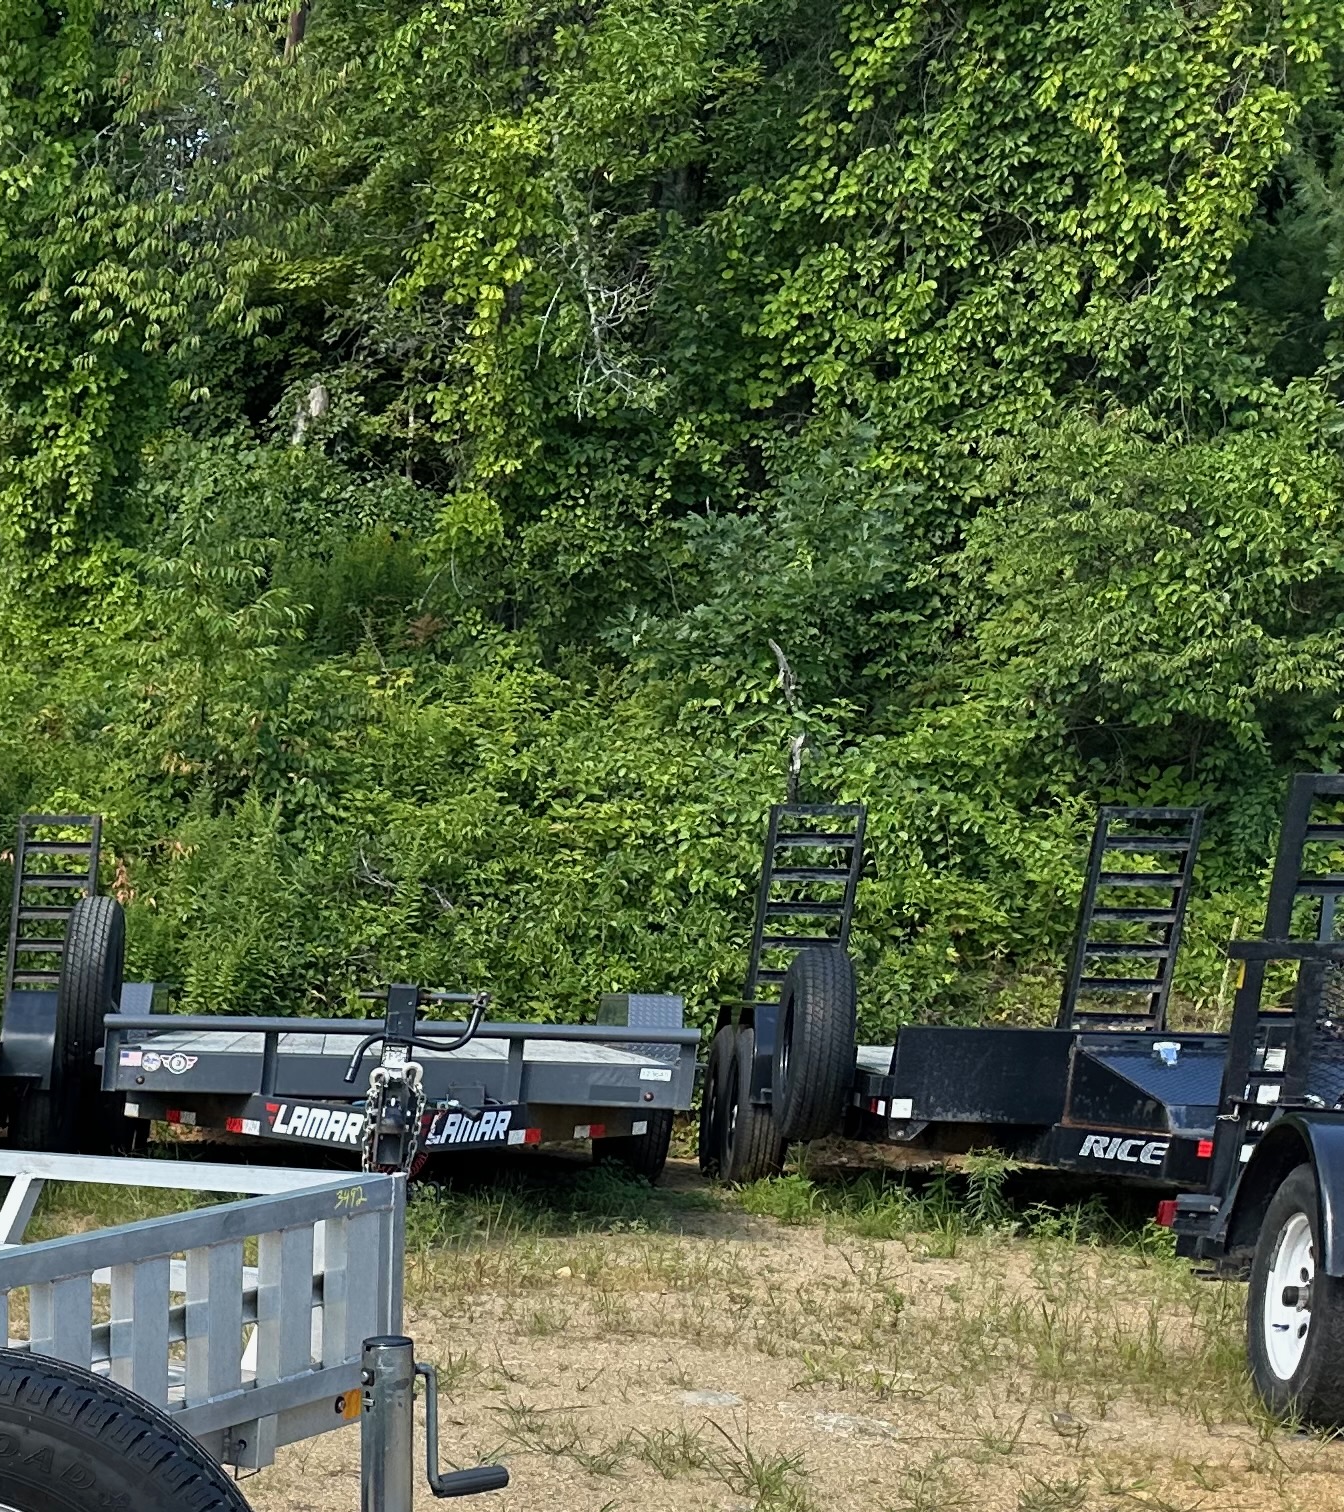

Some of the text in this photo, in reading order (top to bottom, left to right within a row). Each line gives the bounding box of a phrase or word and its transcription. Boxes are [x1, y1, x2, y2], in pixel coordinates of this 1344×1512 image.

[272, 1103, 365, 1145] LAMAR
[425, 1110, 512, 1146] LAMAR
[1078, 1134, 1170, 1165] RICE
